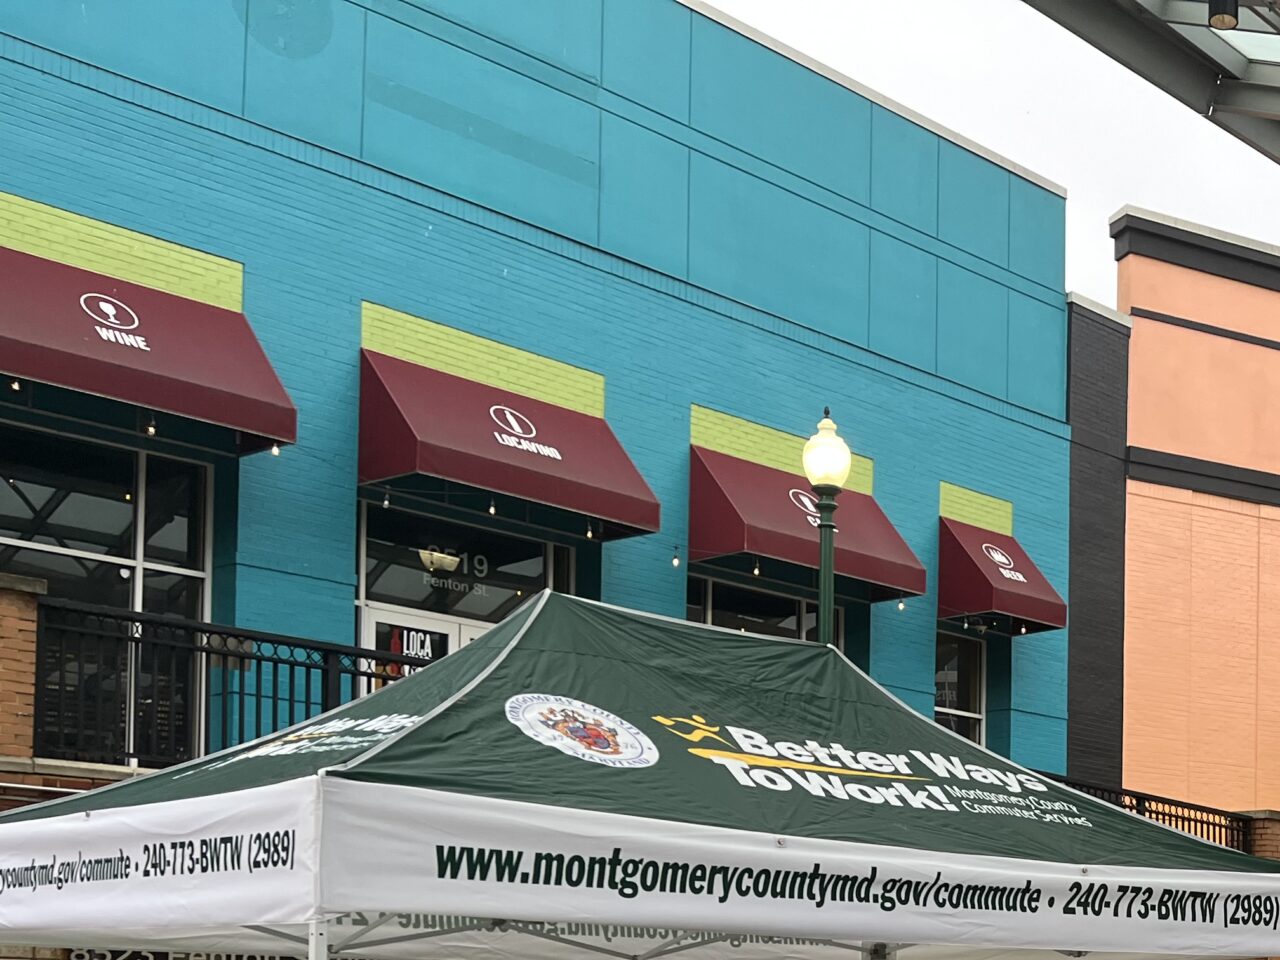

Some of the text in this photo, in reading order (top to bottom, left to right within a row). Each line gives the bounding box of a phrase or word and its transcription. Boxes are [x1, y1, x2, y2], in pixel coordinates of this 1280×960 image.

[94, 325, 151, 352] WINE
[493, 431, 562, 460] LOCAVINO
[423, 574, 469, 593] Fenton
[998, 567, 1028, 583] BEER
[402, 629, 433, 659] LOCA
[725, 725, 1049, 793] Better Ways
[944, 784, 1081, 815] Montgomery County
[961, 799, 1038, 821] Commuter
[143, 835, 244, 878] 240-773-BWTW
[249, 829, 296, 874] (2989)
[436, 845, 1280, 931] www.montgomerycountymd.gov/commute 240-773-BWTW (2989)
